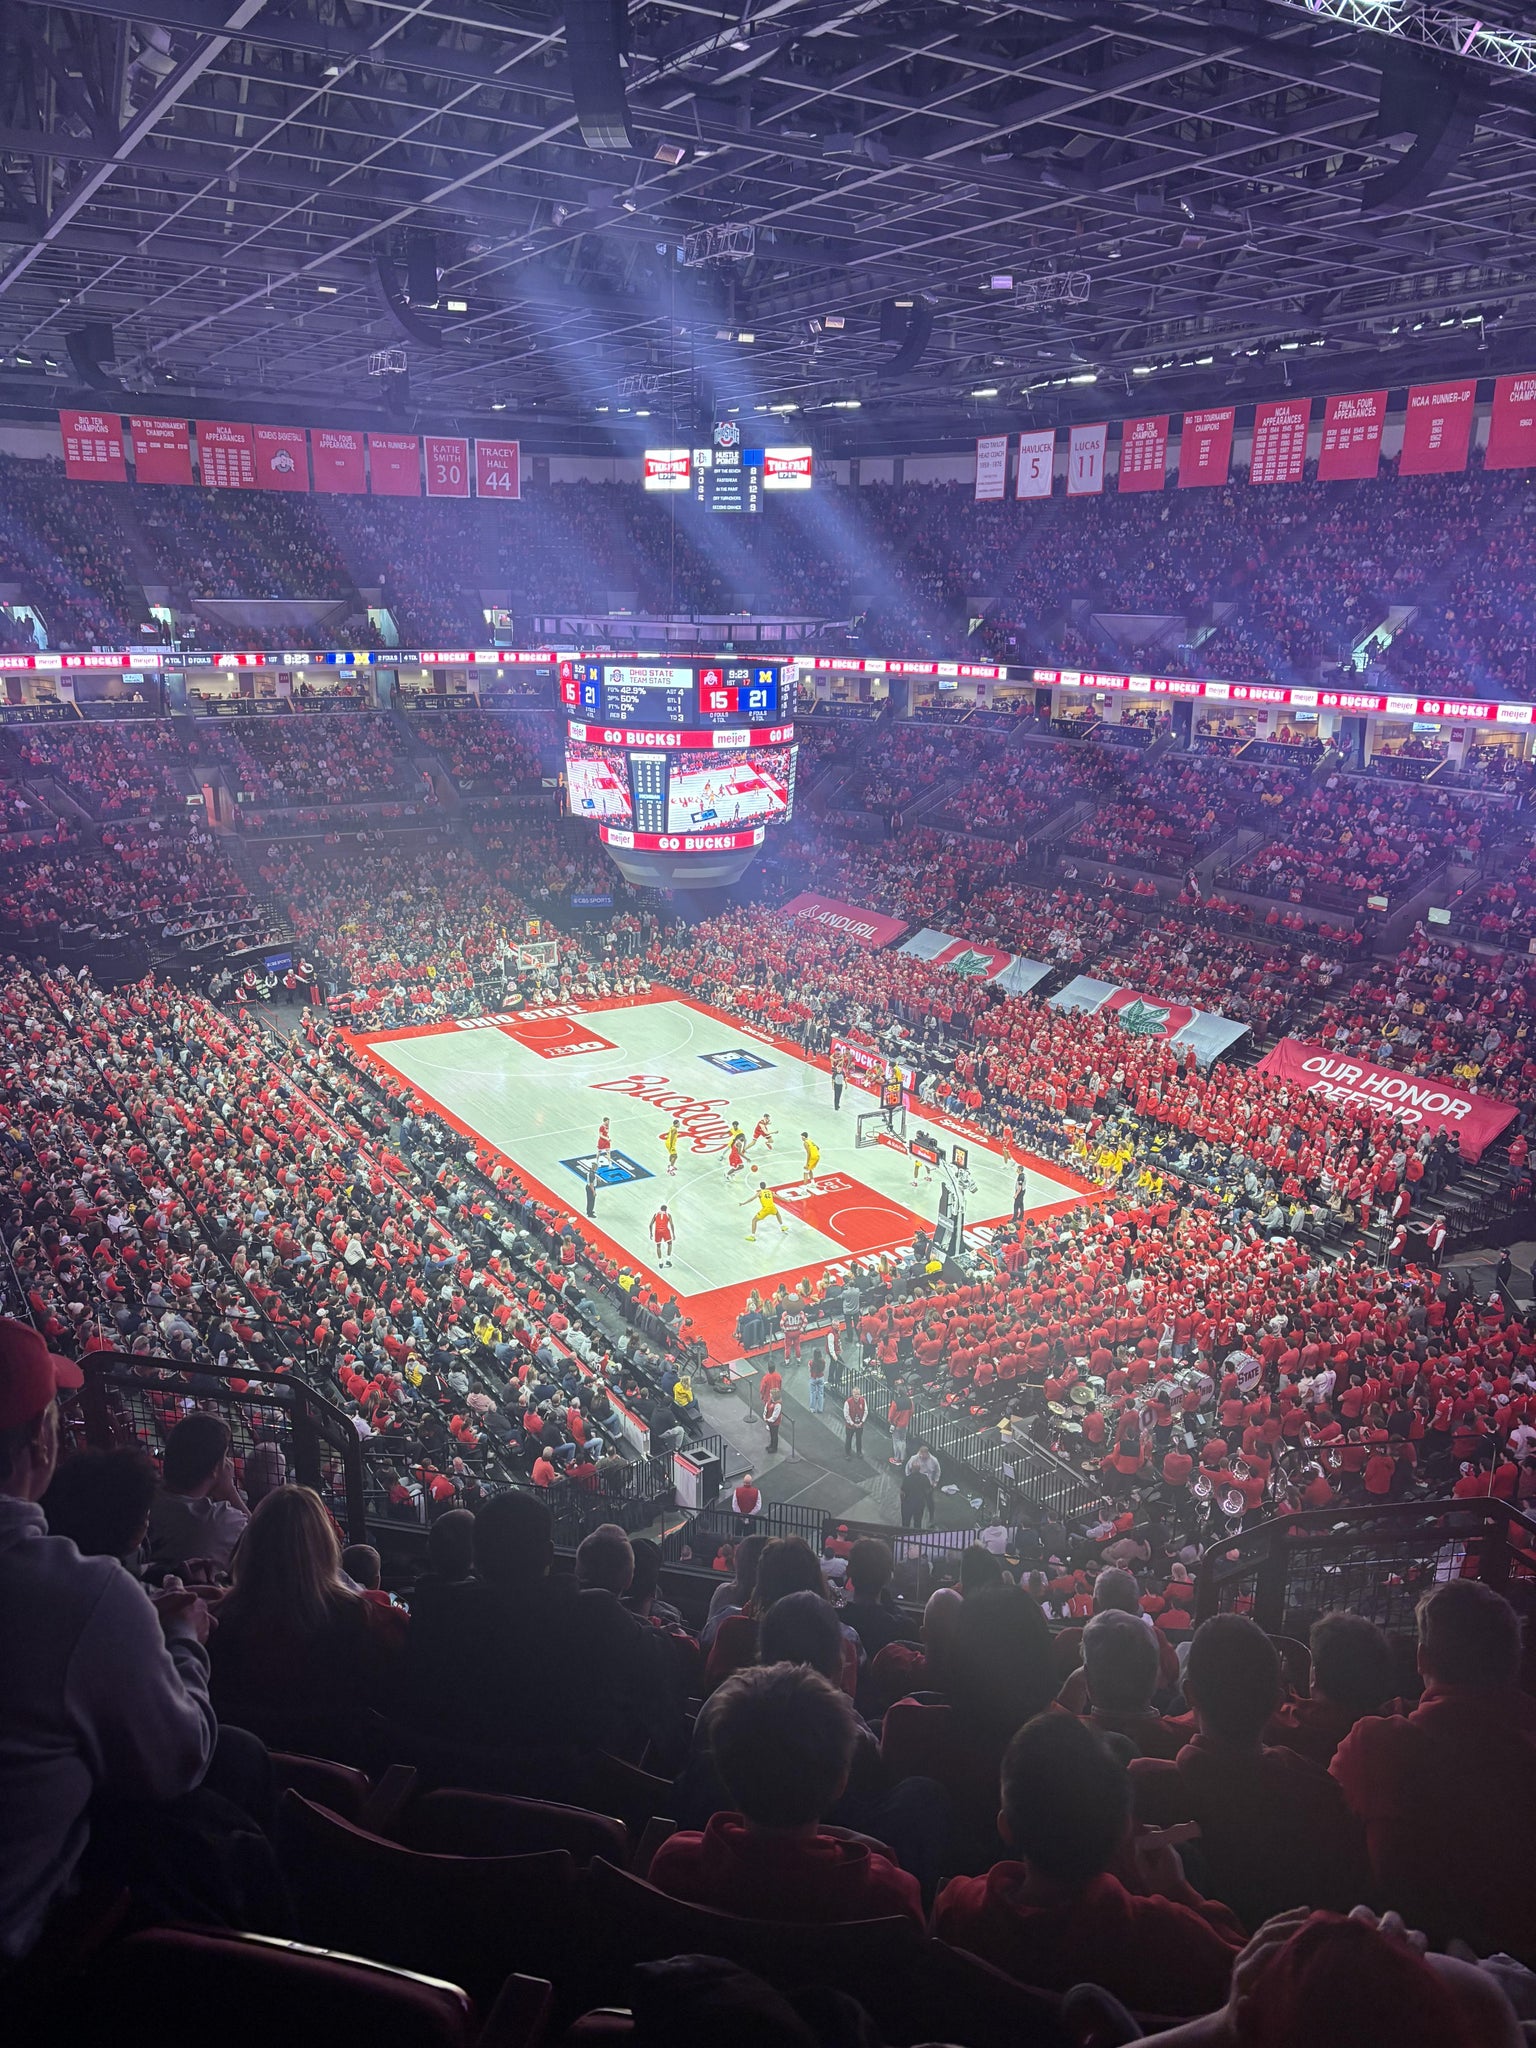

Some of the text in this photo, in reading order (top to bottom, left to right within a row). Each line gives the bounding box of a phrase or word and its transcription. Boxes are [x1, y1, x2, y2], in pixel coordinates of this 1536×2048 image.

[1514, 381, 1536, 392] NATIO
[1338, 398, 1373, 410] FINAL FOUR
[1412, 391, 1470, 407] NCAA RUNNER-UP
[1275, 406, 1290, 416] NCAA
[1333, 407, 1376, 420] APPEARANCES
[1262, 414, 1302, 427] APPEARANCES
[74, 424, 108, 433] CHAMPIONS
[205, 433, 245, 443] APPEARANCES
[320, 440, 356, 450] APPEARANCES
[433, 445, 460, 454] KATIE
[1075, 441, 1100, 451] LUCAS
[434, 454, 460, 462] SMITH
[481, 448, 515, 457] TRACEY
[487, 460, 508, 468] HALL
[788, 460, 808, 471] FAN
[1031, 458, 1040, 478] 5
[1079, 455, 1094, 477] 11
[437, 465, 460, 484] 30
[486, 472, 511, 491] 44
[749, 485, 757, 493] 12
[66, 657, 122, 666] GO BUCKS!
[284, 654, 309, 665] 9:23
[336, 654, 346, 663] 21
[423, 652, 469, 662] GO BUCKS!
[504, 652, 516, 662] GO
[890, 663, 900, 671] GO
[961, 666, 970, 675] GO
[728, 670, 748, 678] 9:23
[759, 671, 772, 683] M
[1084, 676, 1094, 685] GO
[1096, 676, 1124, 686] BUCKS!
[1155, 681, 1200, 693] GO BUCKS!
[566, 683, 575, 700] 15
[585, 686, 595, 704] 21
[1234, 688, 1284, 700] GO BUCKS!
[1294, 693, 1314, 702] meijer
[710, 691, 728, 709] 15
[749, 690, 767, 708] 21
[1323, 695, 1380, 708] GO BUCKS!
[1390, 701, 1413, 710] meijer
[1423, 702, 1490, 717] GO BUCKS!
[1501, 709, 1528, 719] meijer
[604, 731, 681, 745] GO BUCKS!
[717, 733, 746, 745] meijer
[770, 730, 781, 742] GO
[610, 832, 630, 846] meijer
[658, 836, 735, 849] GO BUCKS!
[815, 911, 878, 939] ANDURIL
[455, 1004, 588, 1029] OHIO STATE
[1301, 1056, 1472, 1120] OUR HONOR
[788, 1316, 800, 1325] 00
[1238, 1367, 1259, 1385] STATE
